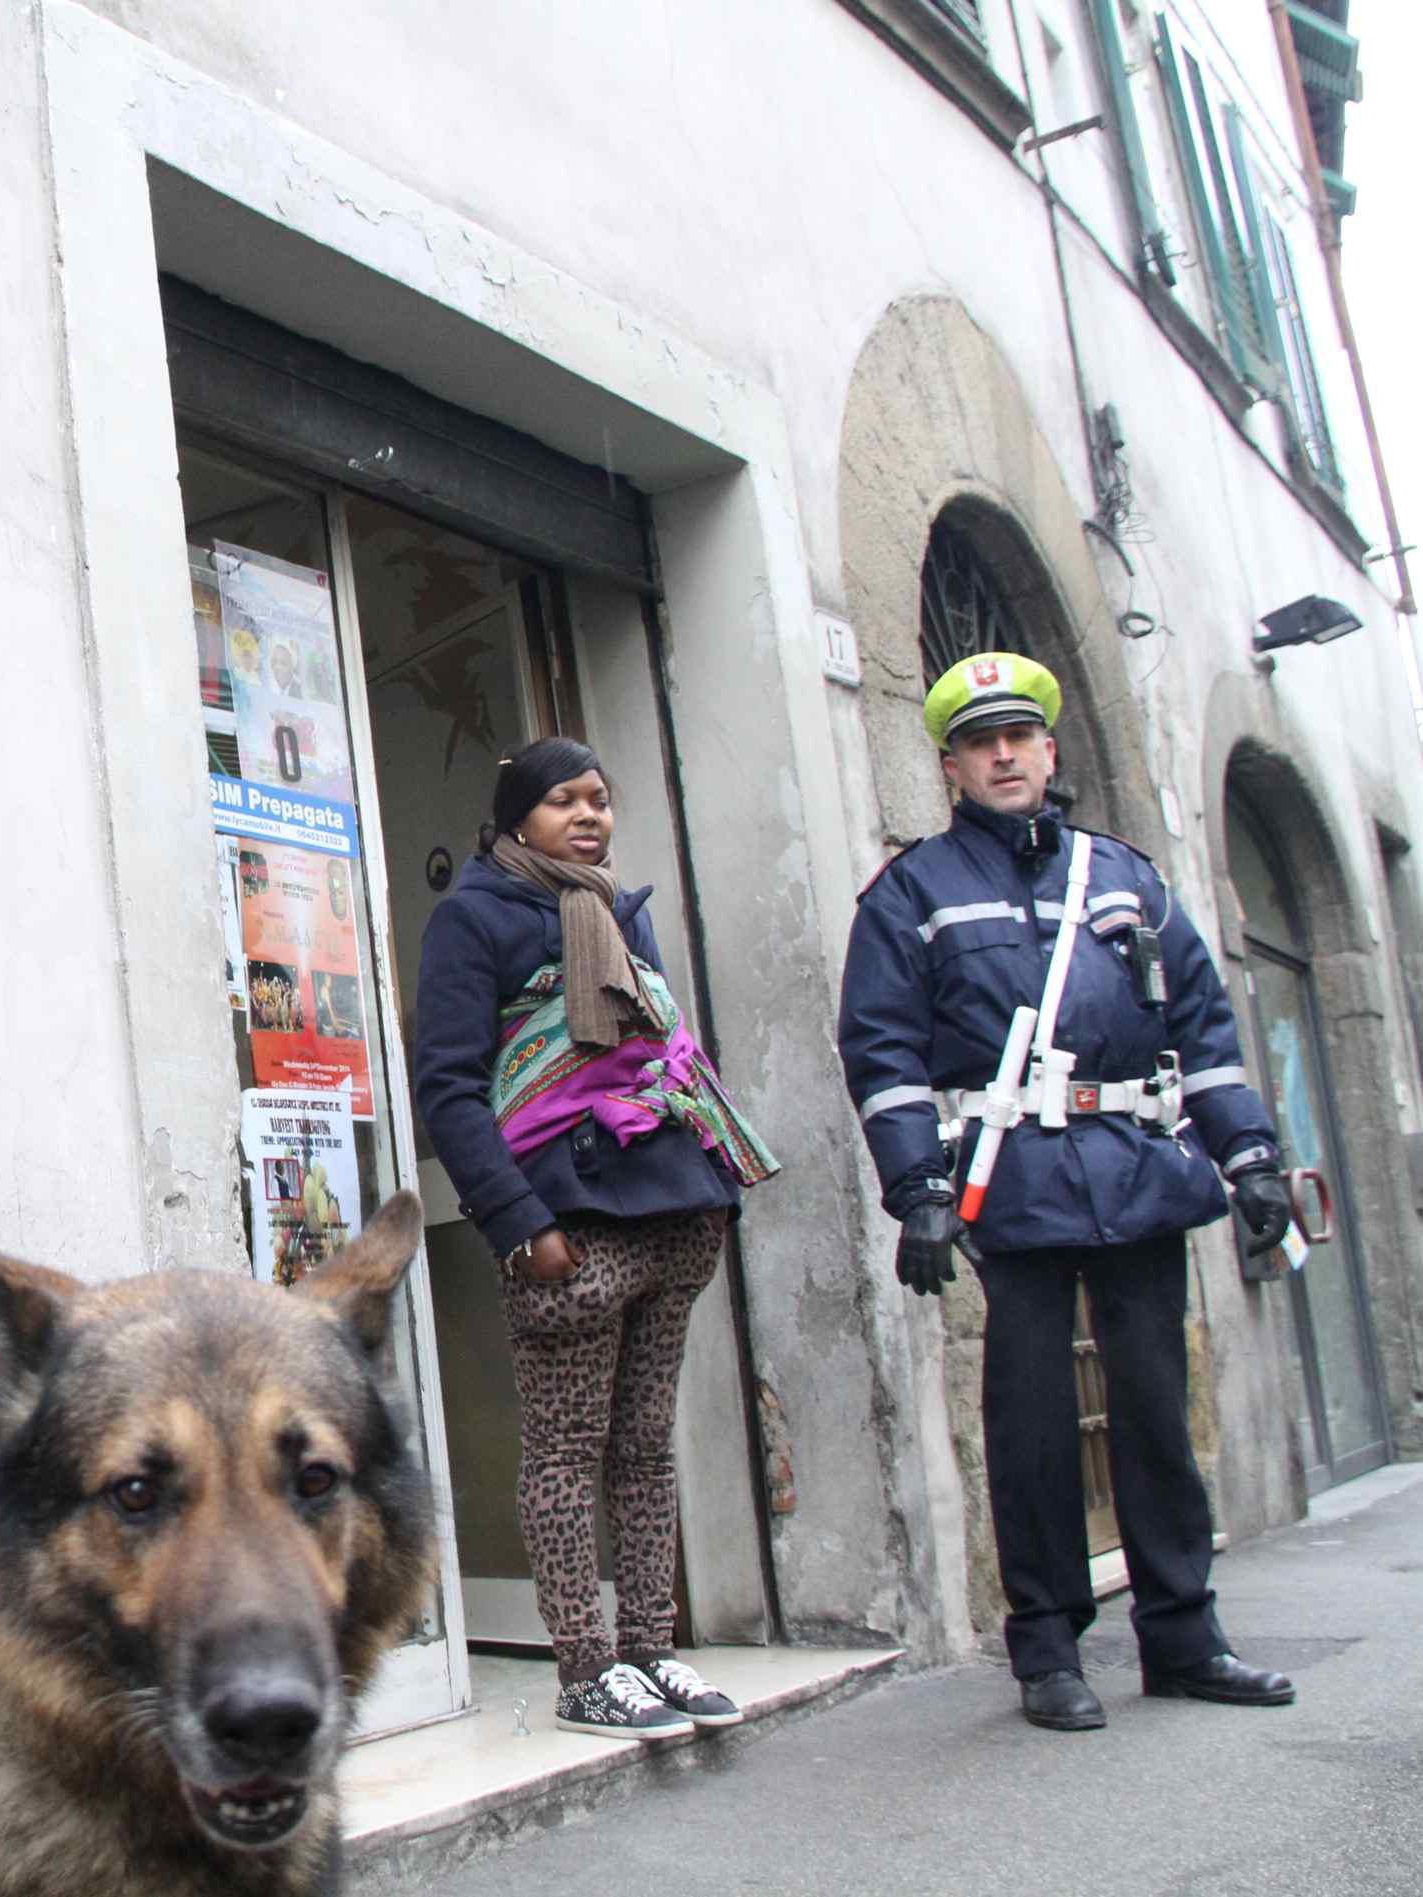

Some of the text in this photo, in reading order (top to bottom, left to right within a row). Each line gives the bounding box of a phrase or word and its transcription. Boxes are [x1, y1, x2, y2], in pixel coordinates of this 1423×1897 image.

[826, 625, 844, 660] 17
[209, 778, 344, 829] SIM Prepagata
